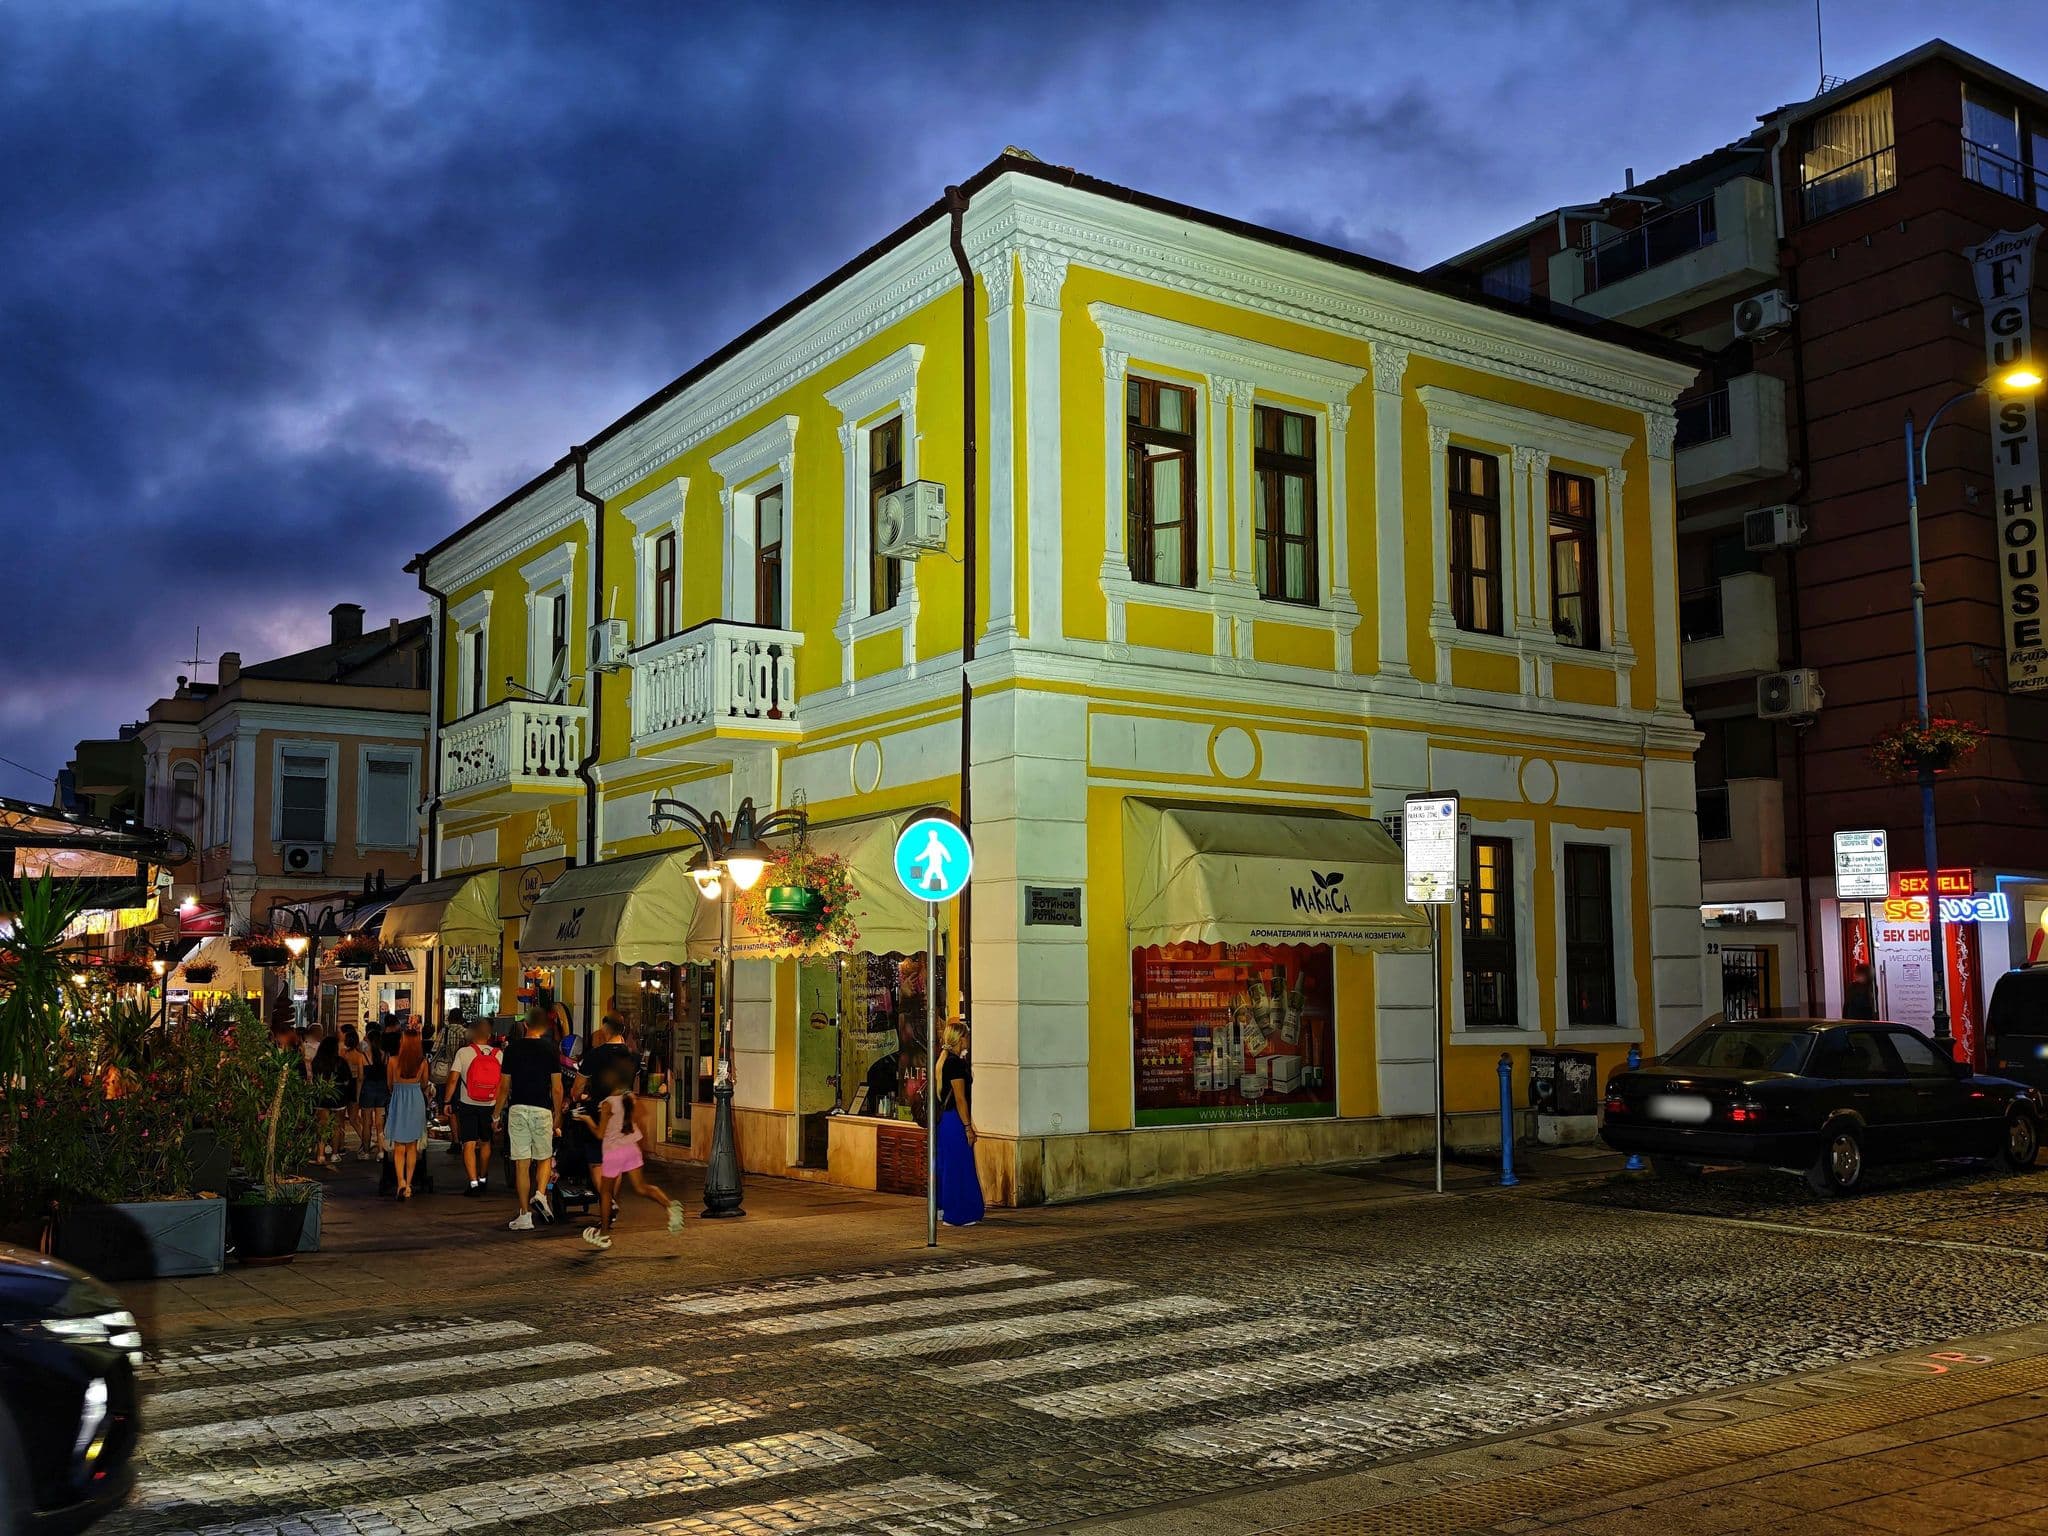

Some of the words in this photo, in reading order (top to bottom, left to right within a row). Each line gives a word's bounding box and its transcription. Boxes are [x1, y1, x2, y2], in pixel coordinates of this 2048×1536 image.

[1991, 307, 2027, 466] GUST
[2004, 484, 2042, 648] HOUSE
[1900, 877, 1969, 892] SEXELL
[1364, 931, 1406, 939] КОЗМЕТИКА
[1883, 929, 1905, 942] SEX
[1908, 929, 1931, 942] SHO
[1707, 942, 1719, 954] 22
[1889, 954, 1931, 962] WELCOME
